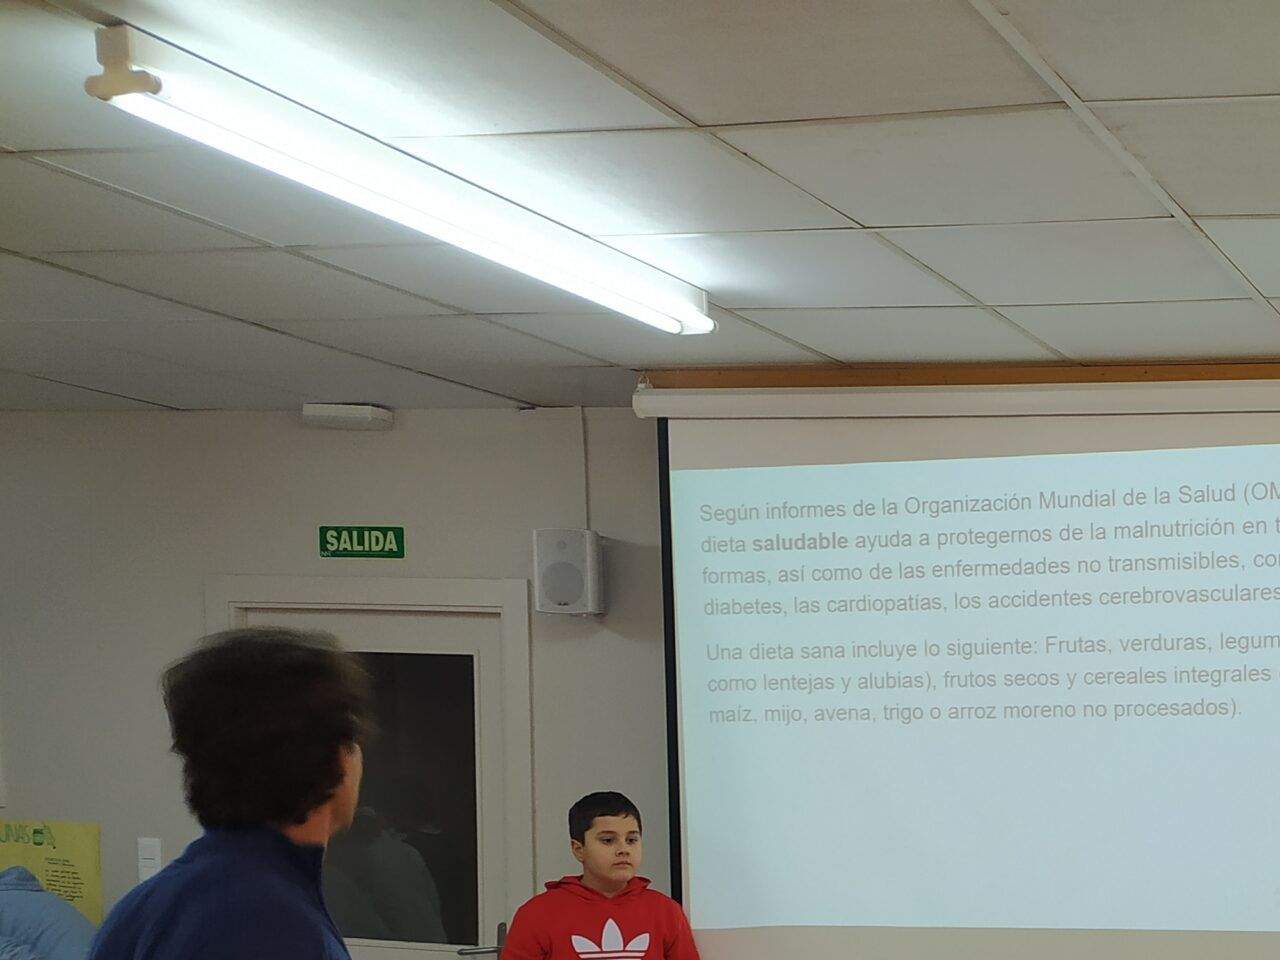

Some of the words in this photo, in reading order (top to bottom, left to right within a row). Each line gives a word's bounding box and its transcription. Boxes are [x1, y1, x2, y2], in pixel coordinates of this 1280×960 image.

[698, 503, 760, 525] Según
[765, 501, 846, 520] informes
[852, 500, 876, 517] de
[881, 498, 898, 516] la
[903, 493, 1032, 517] Organización
[1039, 489, 1116, 509] Mundial
[1122, 488, 1147, 506] de
[1153, 486, 1171, 505] la
[1178, 484, 1236, 504] Salud
[326, 530, 398, 551] SALIDA
[700, 535, 746, 553] dieta
[752, 532, 849, 552] saludable
[854, 530, 912, 552] ayuda
[918, 533, 931, 547] a
[936, 526, 1052, 550] protegernos
[1058, 524, 1084, 542] de
[1090, 523, 1107, 540] la
[1114, 519, 1236, 540] malnutrición
[1242, 518, 1268, 535] en
[702, 565, 772, 586] formas,
[776, 564, 805, 584] así
[811, 565, 863, 582] como
[869, 562, 893, 581] de
[898, 561, 926, 580] las
[931, 558, 1071, 579] enfermedades
[1076, 558, 1102, 575] no
[1107, 552, 1246, 574] transmisibles,
[703, 596, 788, 618] diabetes,
[793, 595, 821, 615] las
[826, 594, 948, 616] cardiopatías,
[953, 592, 982, 610] los
[987, 588, 1092, 609] accidentes
[705, 643, 743, 661] Una
[748, 642, 794, 661] dieta
[799, 643, 846, 660] sana
[851, 640, 917, 662] incluye
[923, 640, 940, 657] lo
[946, 638, 1038, 661] siguiente:
[1045, 634, 1112, 656] Frutas,
[1118, 632, 1212, 654] verduras,
[707, 676, 757, 694] como
[763, 673, 835, 695] lentejas
[840, 675, 852, 695] y
[857, 670, 937, 693] alubias),
[942, 670, 997, 689] frutos
[1003, 670, 1061, 688] secos
[1065, 671, 1078, 690] y
[1082, 667, 1168, 687] cereales
[1173, 664, 1272, 689] integrales
[708, 705, 758, 725] maíz,
[763, 704, 807, 727] mijo,
[813, 704, 877, 724] avena,
[882, 702, 924, 726] trigo
[929, 704, 941, 721] o
[946, 702, 997, 720] arroz
[1003, 703, 1076, 718] moreno
[1082, 702, 1107, 720] no
[1113, 699, 1242, 723] procesados).
